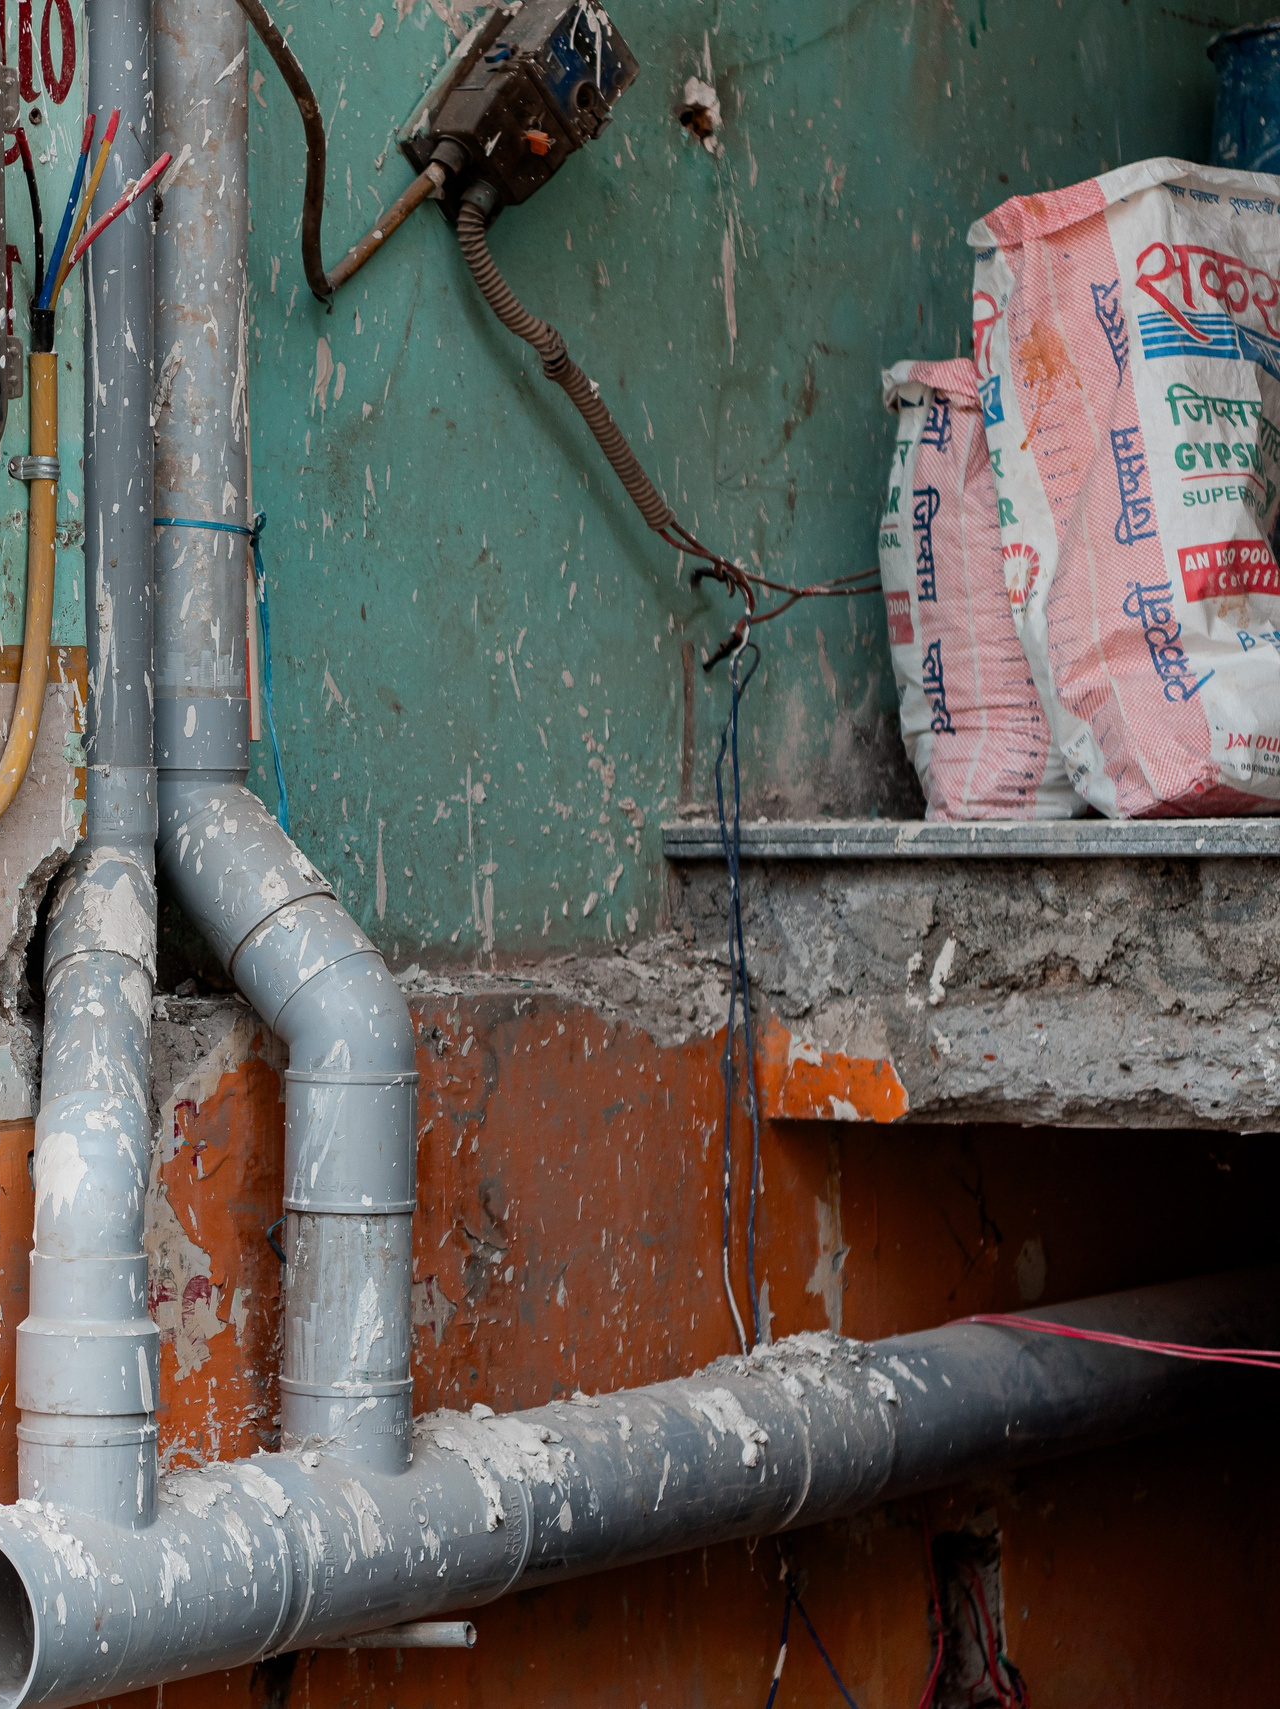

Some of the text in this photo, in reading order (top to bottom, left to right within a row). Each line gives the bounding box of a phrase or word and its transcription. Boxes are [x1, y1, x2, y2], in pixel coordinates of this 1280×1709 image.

[1136, 242, 1280, 343] सकर
[1109, 425, 1157, 547] जिप्सम
[912, 484, 942, 604] जिप्सम
[1184, 551, 1211, 573] AN
[1215, 548, 1236, 567] ISO
[1218, 568, 1280, 590] Certifi
[1224, 733, 1253, 750] JAI
